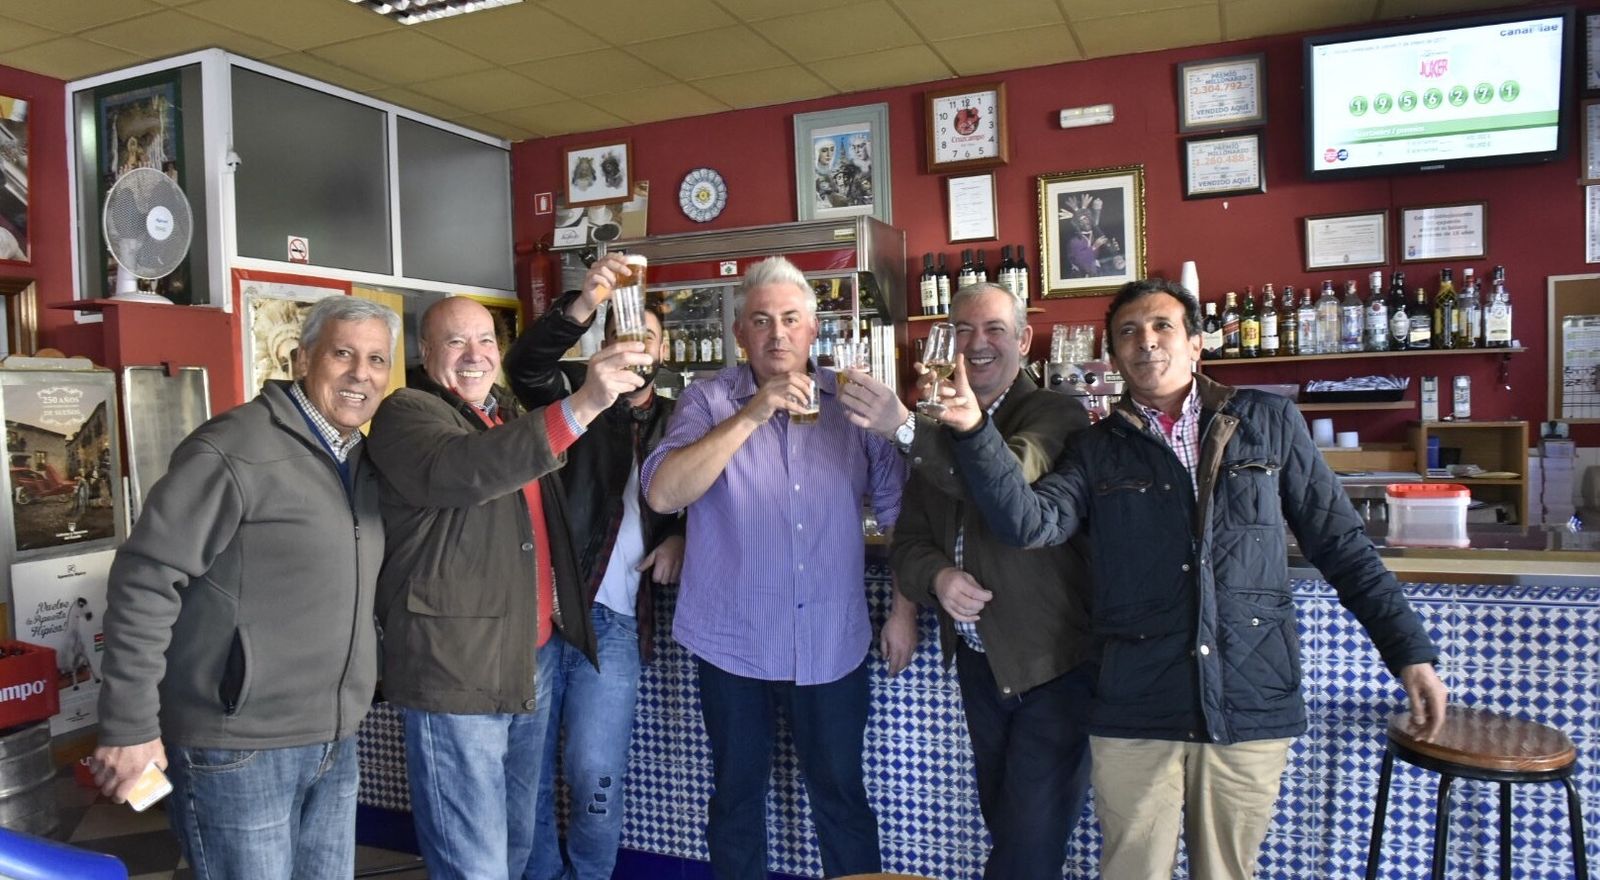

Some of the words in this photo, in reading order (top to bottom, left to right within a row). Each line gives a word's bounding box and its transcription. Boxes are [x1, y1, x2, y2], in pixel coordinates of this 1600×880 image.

[1211, 70, 1238, 79] PREMIO
[949, 101, 956, 109] 11
[961, 98, 971, 107] 12
[977, 97, 982, 105] 1
[987, 106, 994, 115] 2
[1196, 106, 1230, 116] VENDIDO
[939, 112, 949, 121] 10
[988, 121, 994, 129] 3
[941, 127, 947, 135] 9
[941, 141, 947, 149] 8
[952, 150, 958, 158] 7
[964, 150, 970, 158] 6
[978, 147, 984, 155] 5
[1198, 178, 1231, 187] VENDIDO
